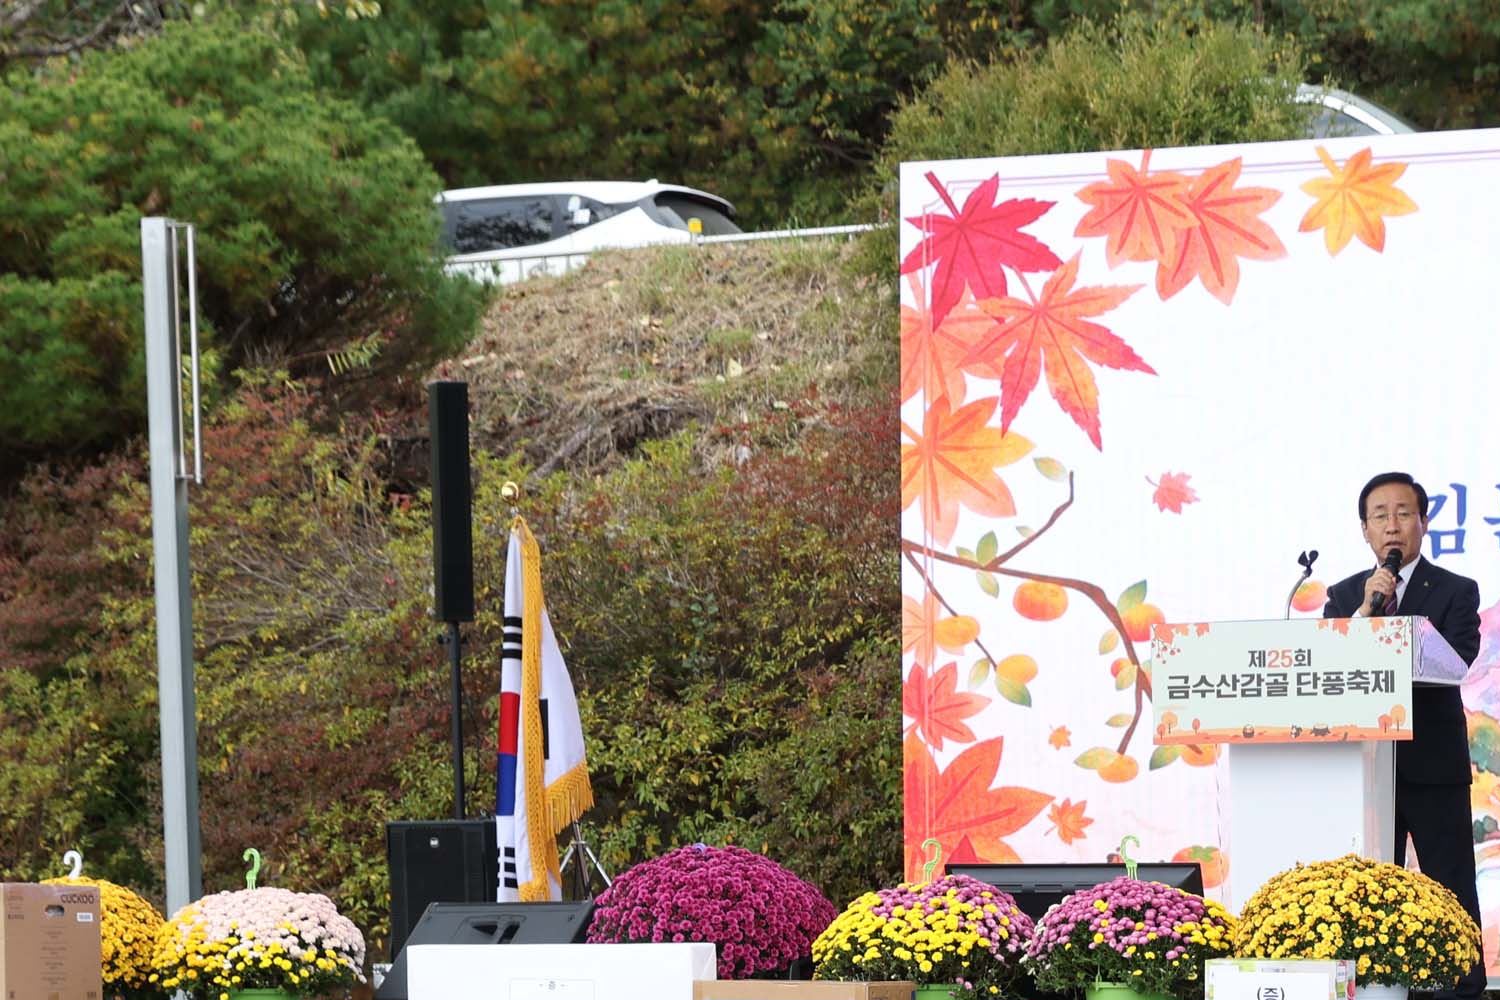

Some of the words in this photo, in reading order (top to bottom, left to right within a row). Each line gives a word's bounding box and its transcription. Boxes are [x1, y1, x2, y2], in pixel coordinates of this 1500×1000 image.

[1247, 648, 1312, 669] 제25회
[1167, 672, 1289, 700] 금수산감골
[1295, 669, 1396, 697] 단풍축제
[60, 893, 95, 904] CUCKOO
